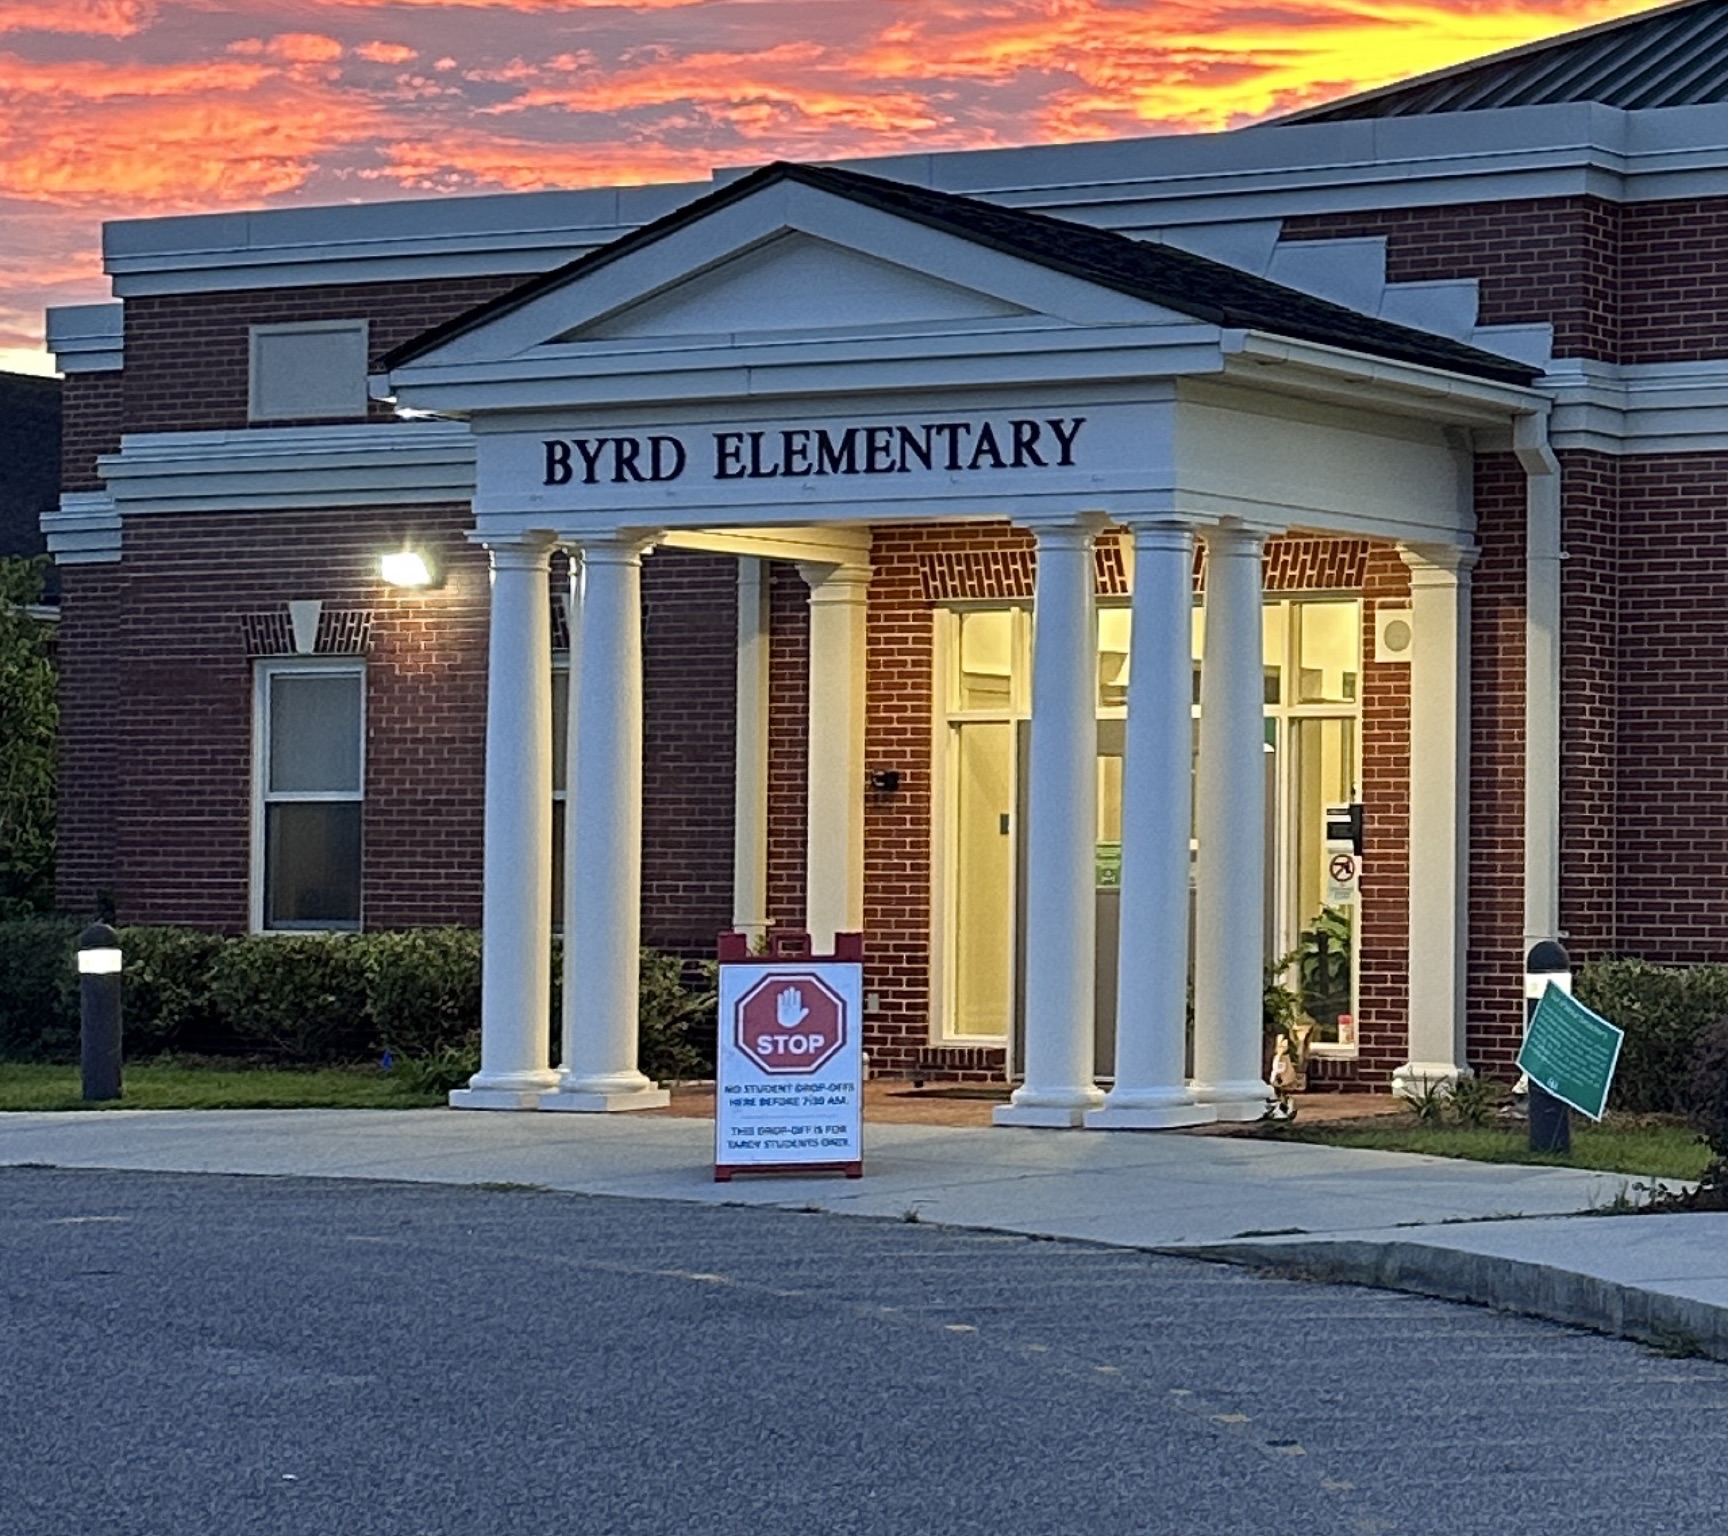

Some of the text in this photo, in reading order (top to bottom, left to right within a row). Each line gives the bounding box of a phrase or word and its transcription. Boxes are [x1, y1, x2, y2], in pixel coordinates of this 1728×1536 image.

[542, 417, 1088, 486] BYRD ELEMENTARY
[757, 1033, 825, 1055] STOP
[724, 1082, 855, 1094] NO STUDENT DROP-OFFS
[729, 1097, 756, 1107] HERE
[759, 1097, 800, 1107] BEFORE
[730, 1125, 847, 1136] THIS DROP-OFF IS FOR
[764, 1138, 819, 1149] STUDENTS
